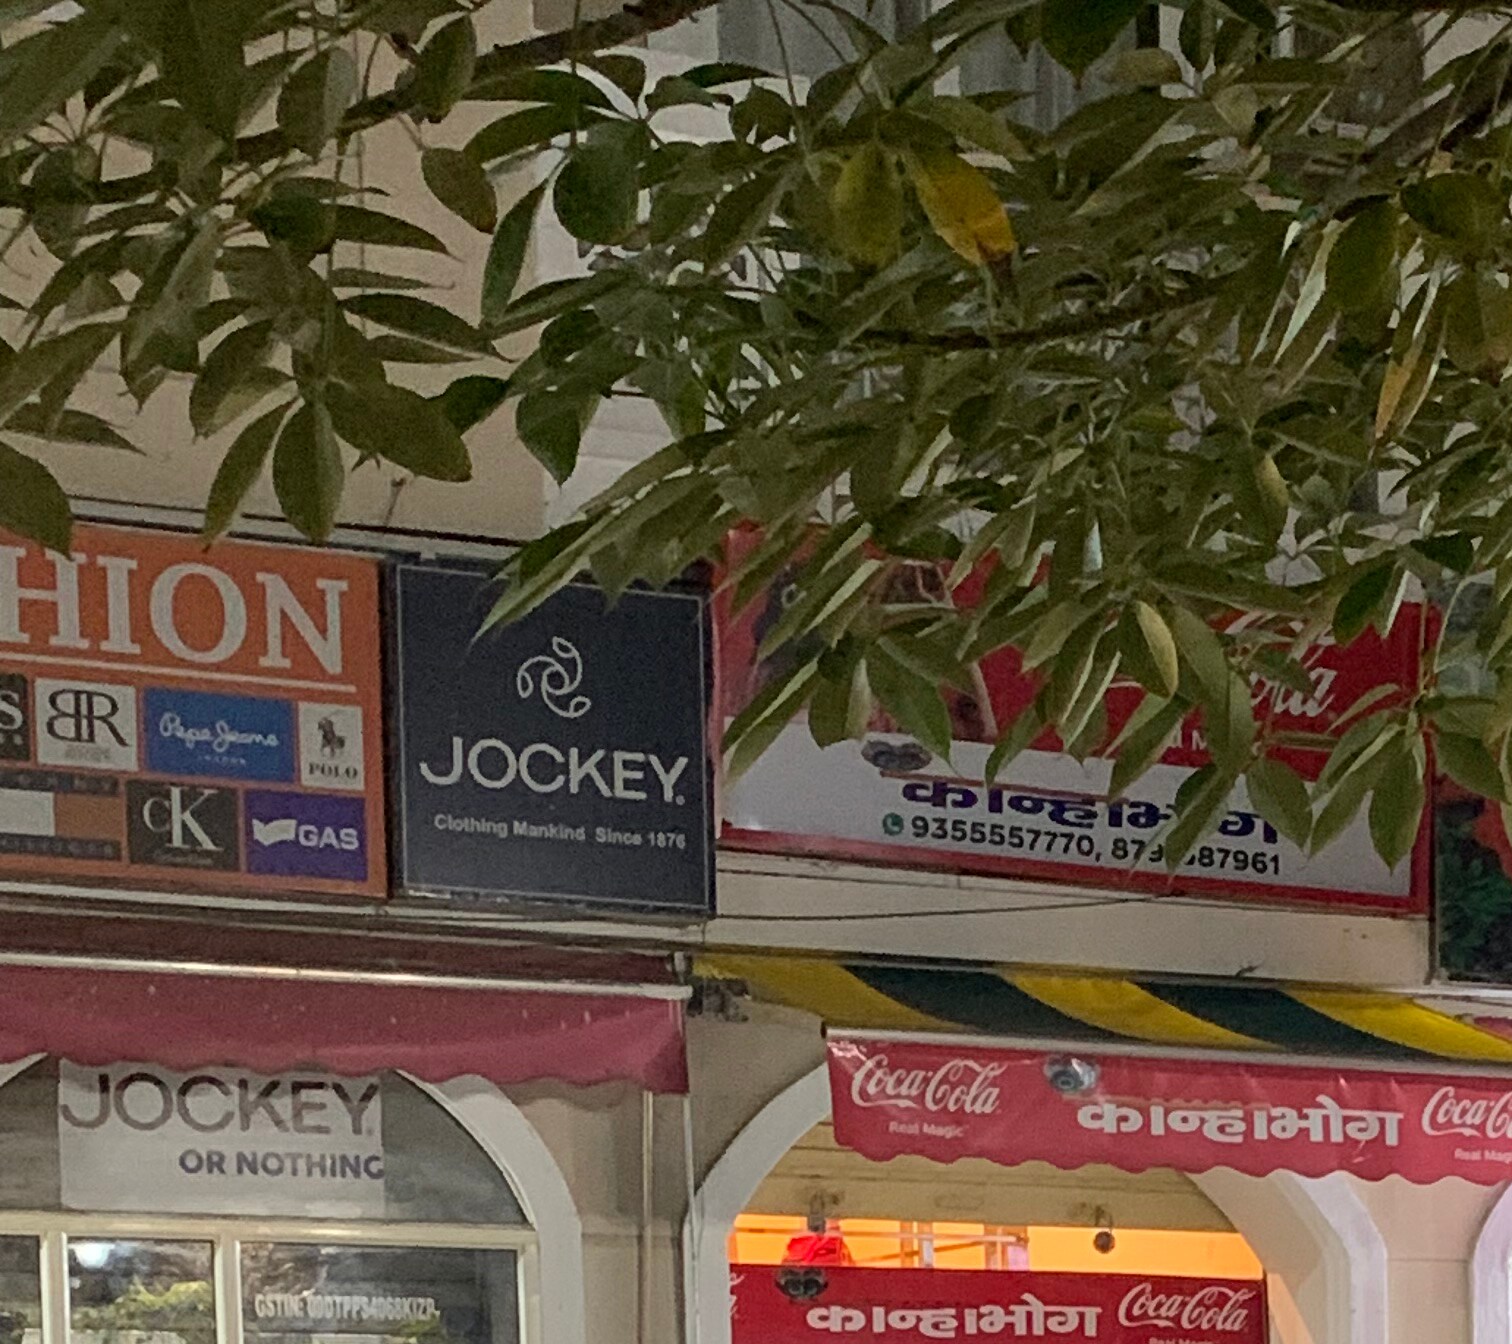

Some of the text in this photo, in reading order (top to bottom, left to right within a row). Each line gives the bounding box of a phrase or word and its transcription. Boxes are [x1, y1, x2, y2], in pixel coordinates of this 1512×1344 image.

[159, 712, 279, 752] Pepe Jeans
[309, 763, 358, 779] POLO
[419, 736, 689, 805] JOCKEY
[300, 825, 359, 849] GAS
[434, 814, 686, 849] Clothing Mankind Since 1876
[852, 1054, 1004, 1114] Coca-Cola
[61, 1072, 379, 1135] JOCKEY
[889, 1121, 964, 1139] Real Magic
[179, 1149, 384, 1180] OR NOTHING
[1455, 1149, 1480, 1161] Real
[1118, 1283, 1255, 1331] Coca-Cola
